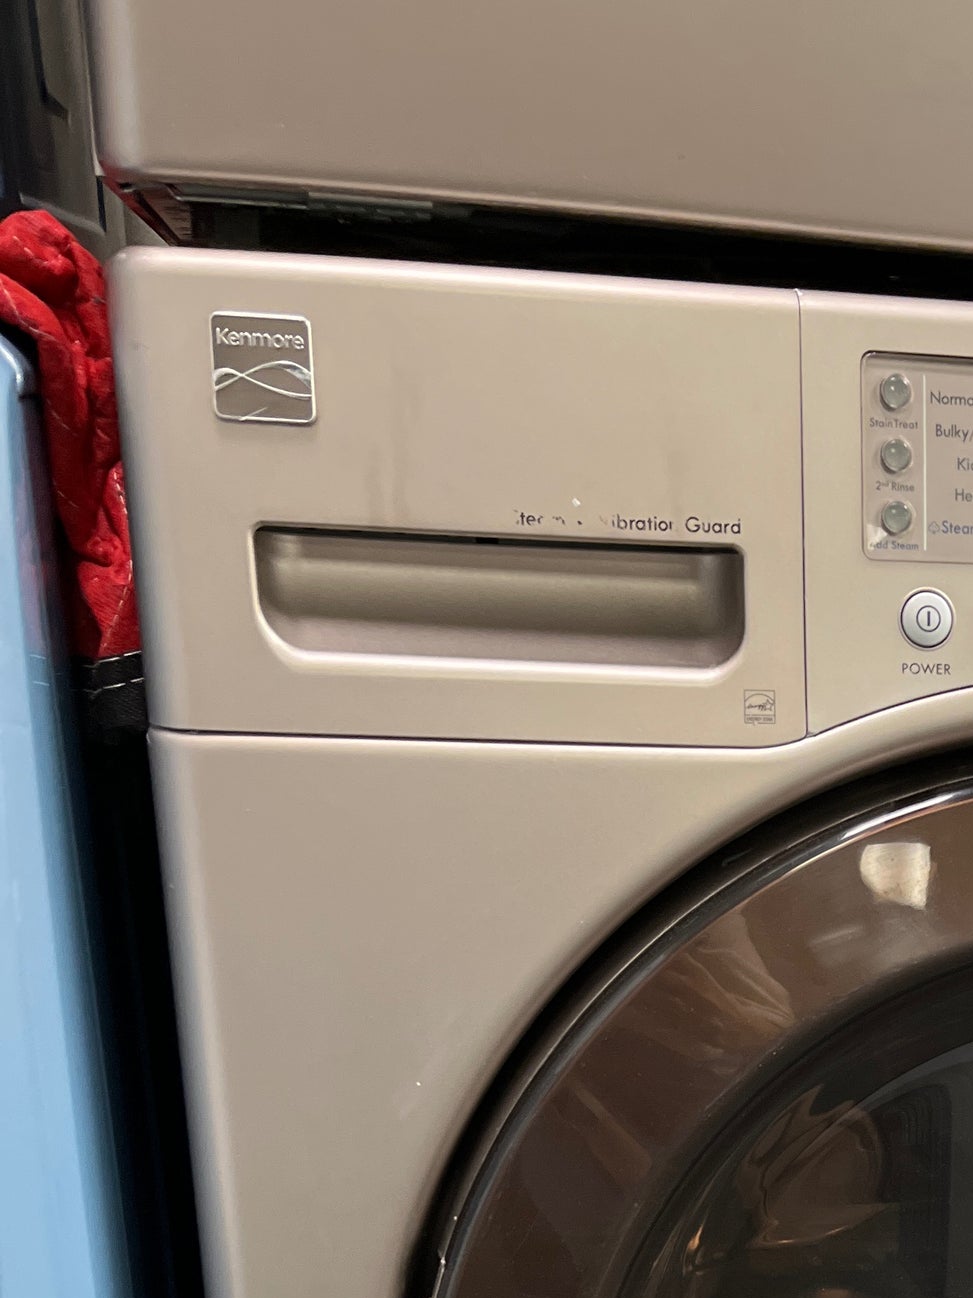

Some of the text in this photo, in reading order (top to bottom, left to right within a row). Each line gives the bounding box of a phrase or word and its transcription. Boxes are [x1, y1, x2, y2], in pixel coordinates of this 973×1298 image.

[216, 327, 304, 349] Kenmore
[869, 418, 918, 430] Stain Treat
[891, 481, 915, 492] Rinse
[685, 516, 741, 534] Guard
[891, 541, 919, 550] Steam
[901, 662, 951, 675] POWER
